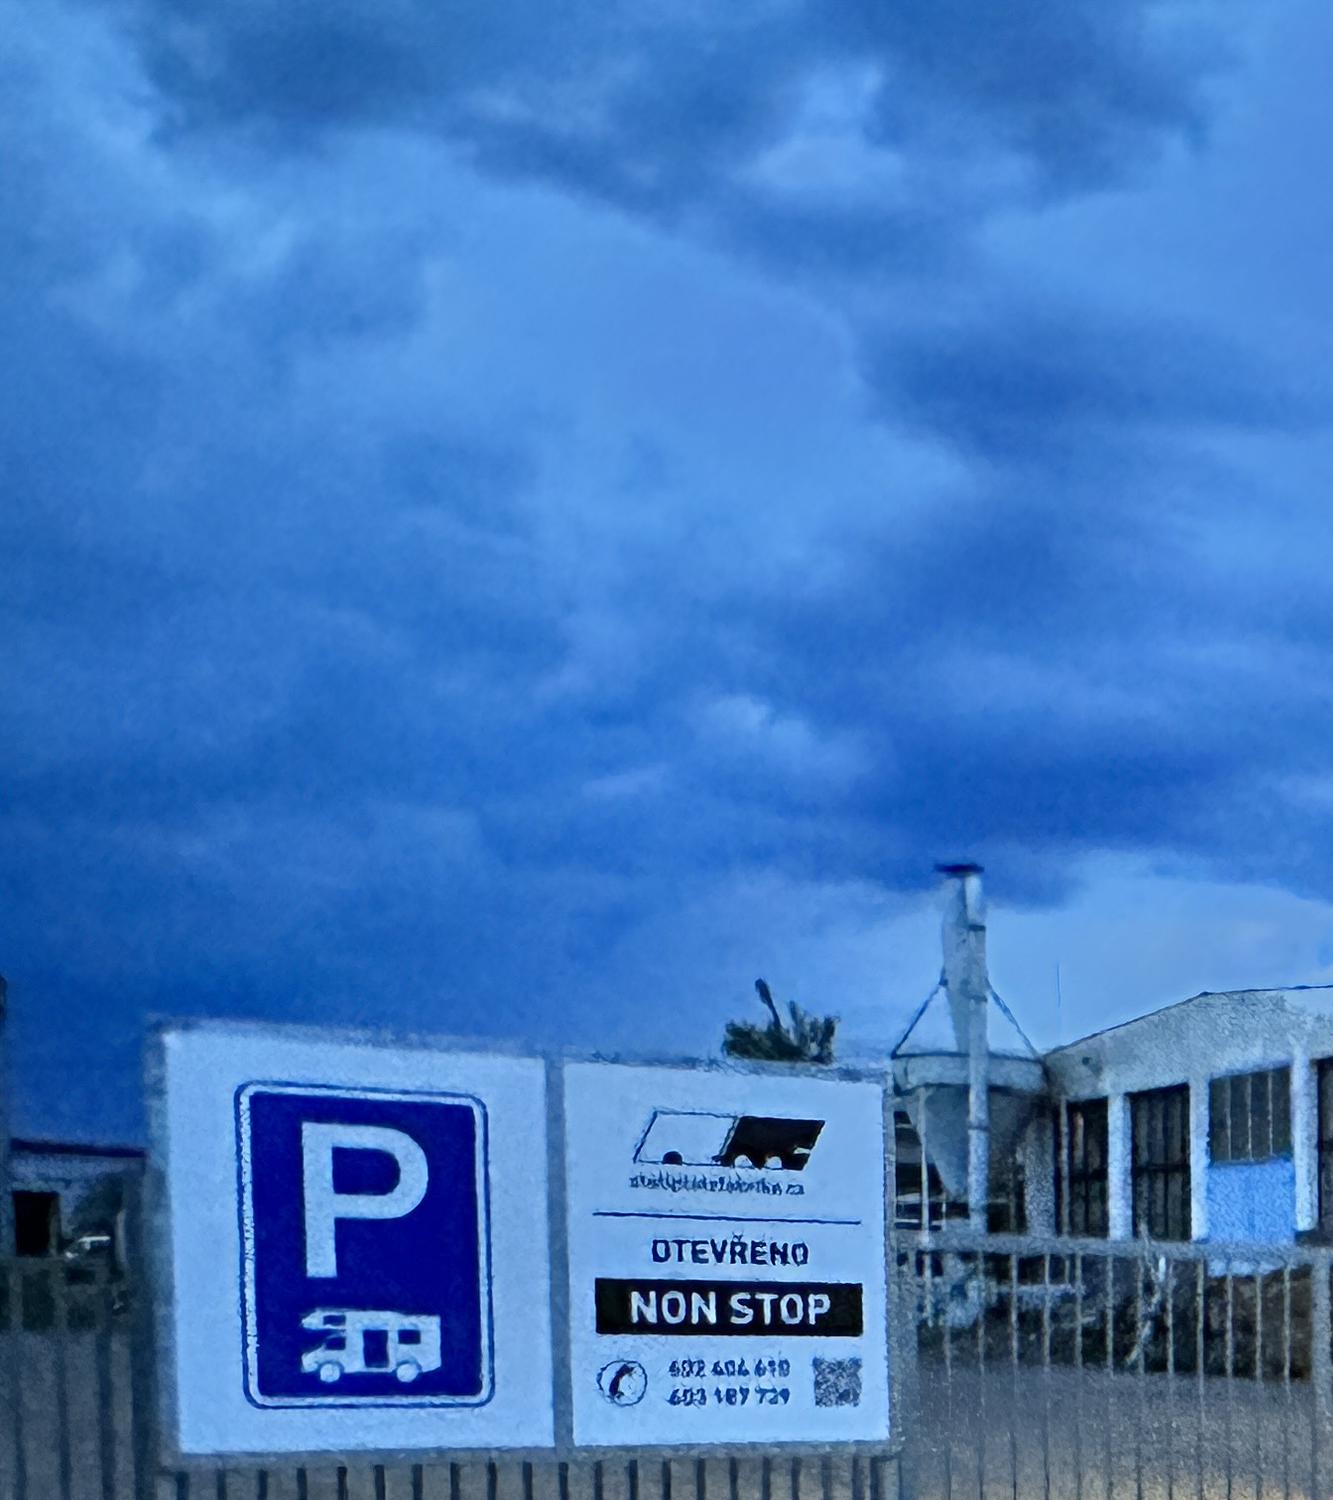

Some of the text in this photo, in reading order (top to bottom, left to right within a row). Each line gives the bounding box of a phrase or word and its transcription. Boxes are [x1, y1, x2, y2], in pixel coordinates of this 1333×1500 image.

[302, 1120, 430, 1278] P
[652, 1232, 809, 1266] OTEVŘENO
[630, 1291, 831, 1325] NON STOP
